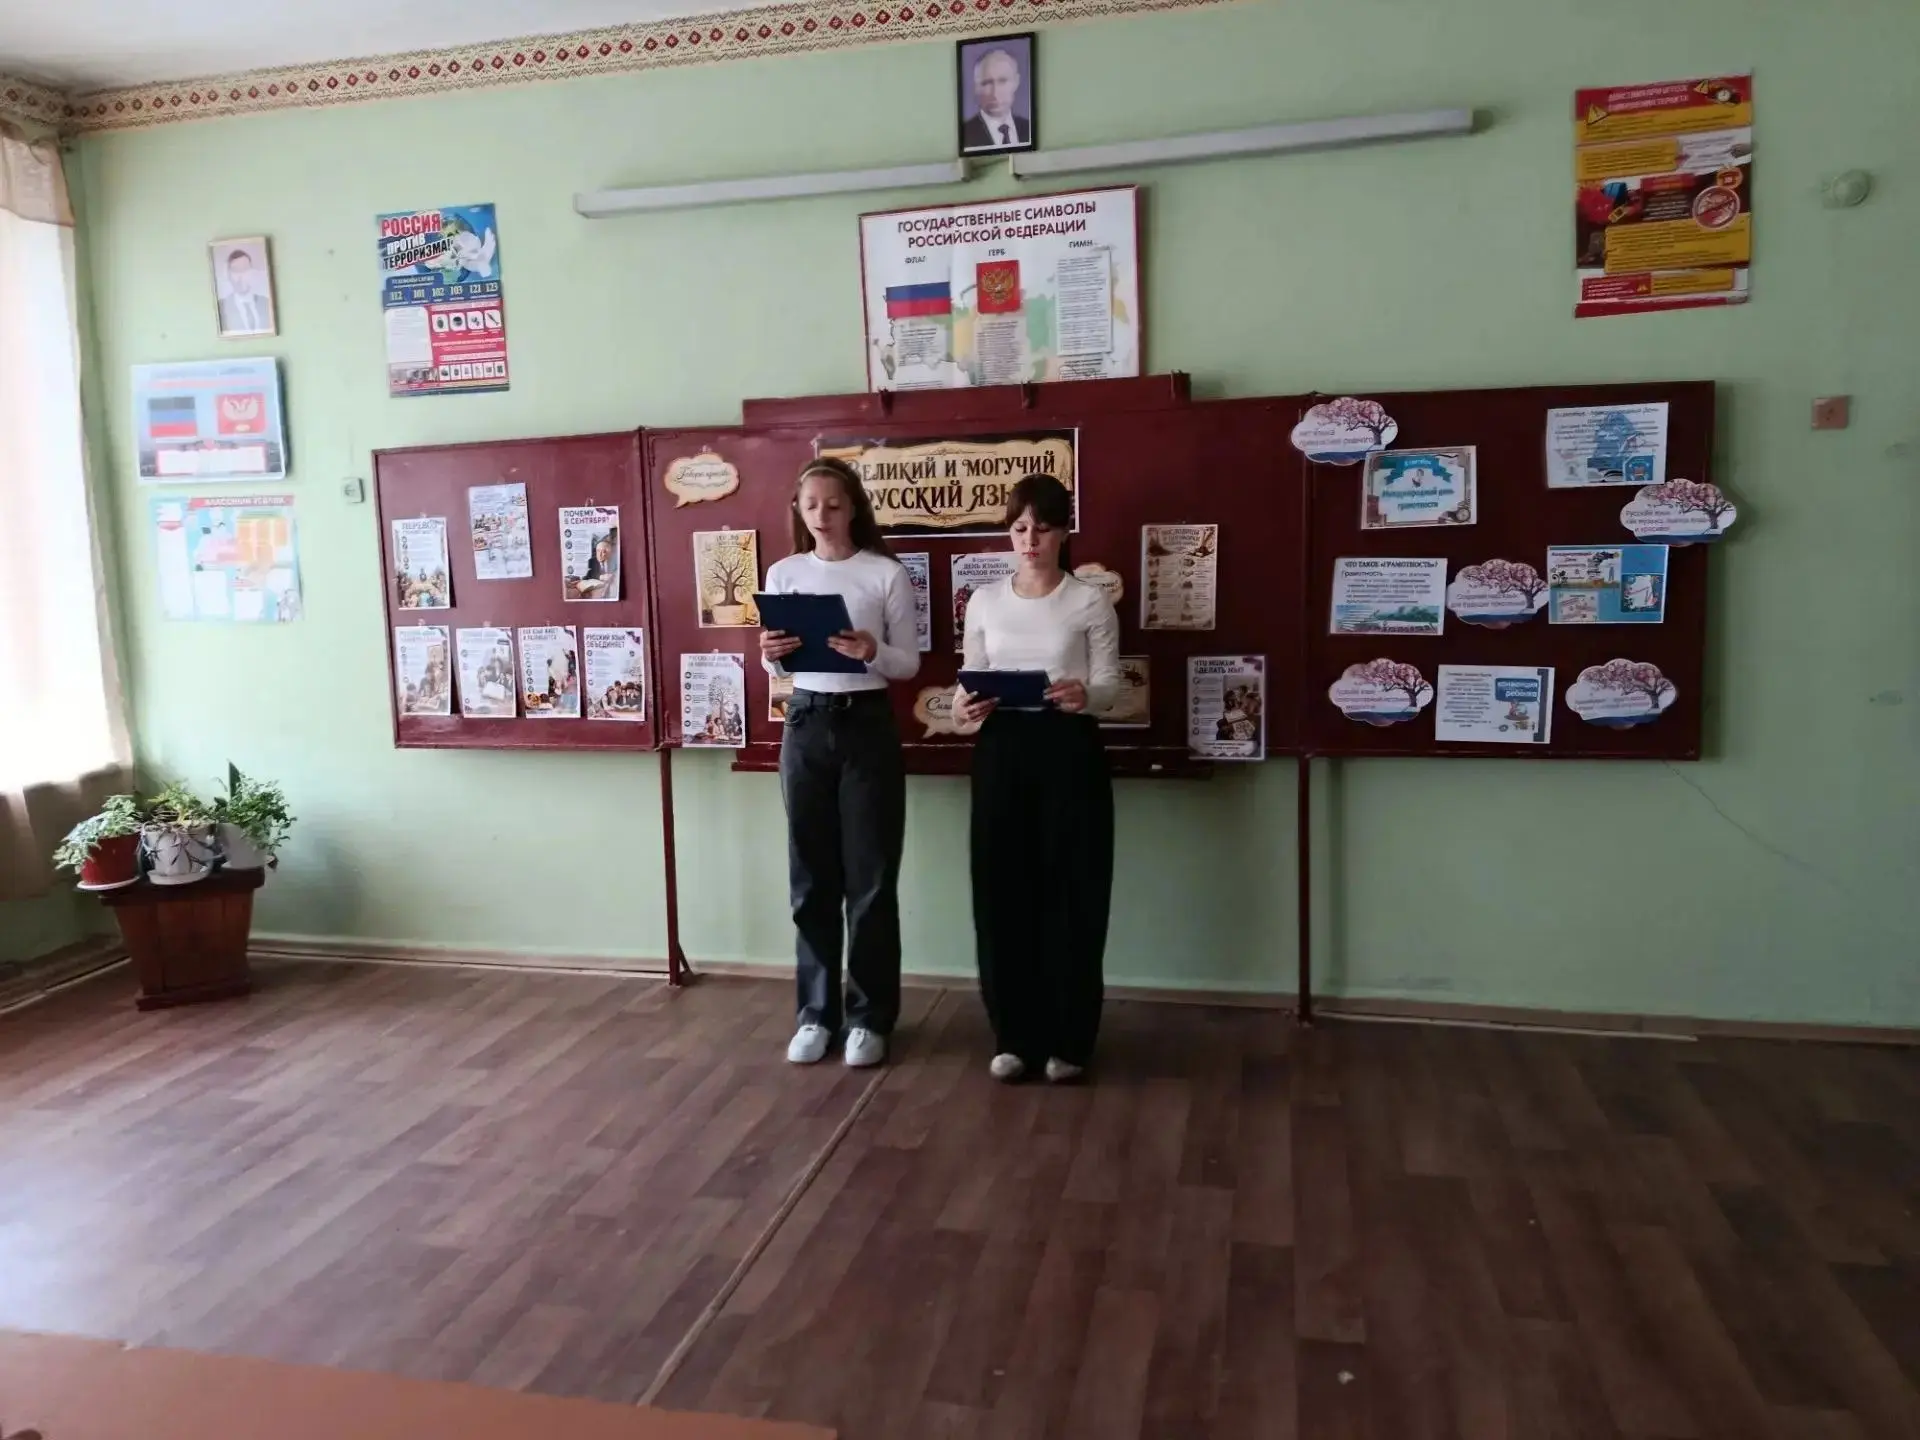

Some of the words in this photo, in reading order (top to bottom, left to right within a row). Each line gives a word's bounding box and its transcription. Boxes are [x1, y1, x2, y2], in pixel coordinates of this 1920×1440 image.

[381, 213, 442, 237] РОССИЯ
[898, 211, 1021, 233] ГОСУДАРСТВЕННЫЕ
[1024, 201, 1096, 220] СИМВОЛЫ
[386, 233, 426, 255] ПРОТИВ
[908, 226, 1001, 248] РОССИЙСКОЙ
[1005, 220, 1086, 239] ФЕДЕРАЦИИ
[1068, 240, 1093, 248] ГИМН
[383, 239, 452, 270] ТЕРРОРИЗМА!
[905, 256, 927, 264] ФЛАГ
[988, 248, 1006, 257] ГЕРБ
[413, 289, 425, 298] 101
[432, 287, 444, 297] 102
[450, 285, 463, 295] 103
[944, 459, 956, 477] И
[962, 450, 1056, 476] МОГУЧИЙ
[965, 483, 1011, 513] ЯЗ
